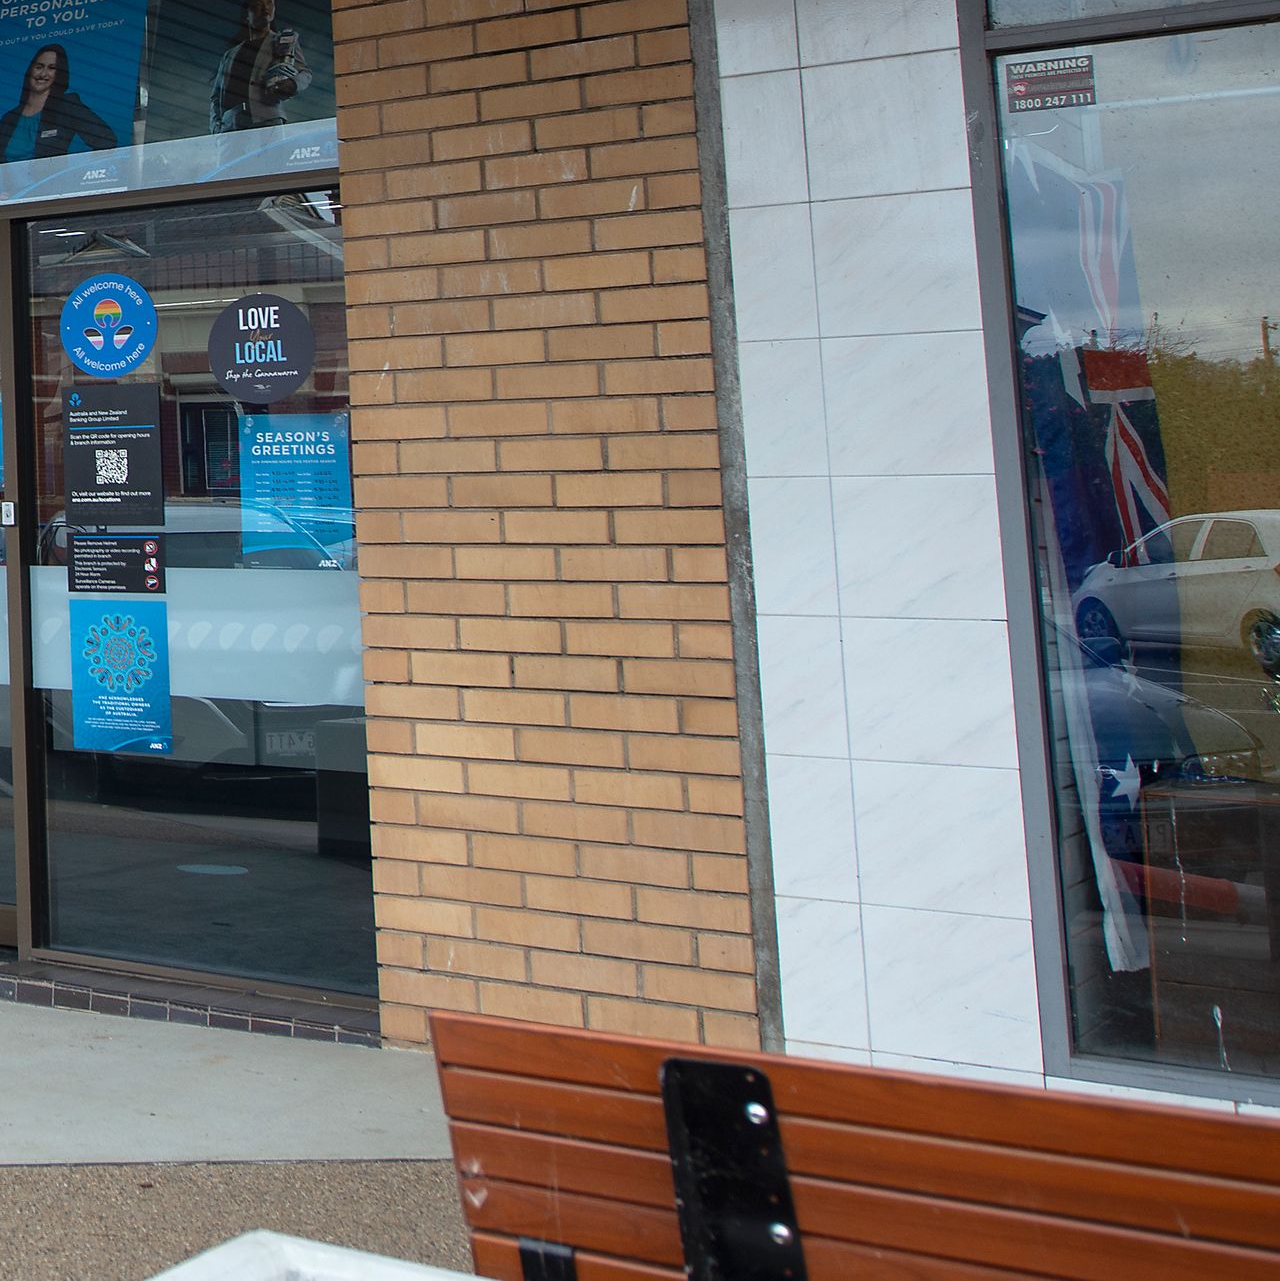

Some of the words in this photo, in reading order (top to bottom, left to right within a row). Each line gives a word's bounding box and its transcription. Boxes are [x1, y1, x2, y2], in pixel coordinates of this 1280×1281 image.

[26, 16, 46, 29] TO
[53, 9, 89, 24] YOU.
[5, 37, 20, 45] OUT
[31, 33, 47, 41] YOU
[48, 28, 74, 38] COULD
[75, 24, 95, 34] SAVE
[1010, 58, 1089, 74] WARNING
[1015, 99, 1041, 109] 1800
[1045, 96, 1067, 106] 247
[1071, 94, 1091, 103] 111
[290, 146, 320, 159] ANZ
[83, 169, 106, 180] ANZ
[72, 296, 84, 309] All
[82, 281, 124, 298] welcome
[124, 285, 143, 305] here
[238, 306, 280, 330] LOVE
[73, 347, 85, 359] All
[84, 356, 126, 371] welcome
[126, 343, 145, 363] here
[235, 340, 287, 364] LOCAL
[225, 369, 240, 382] Shop
[242, 369, 252, 378] the
[256, 432, 330, 443] SEASON'S
[252, 444, 335, 455] GREETINGS
